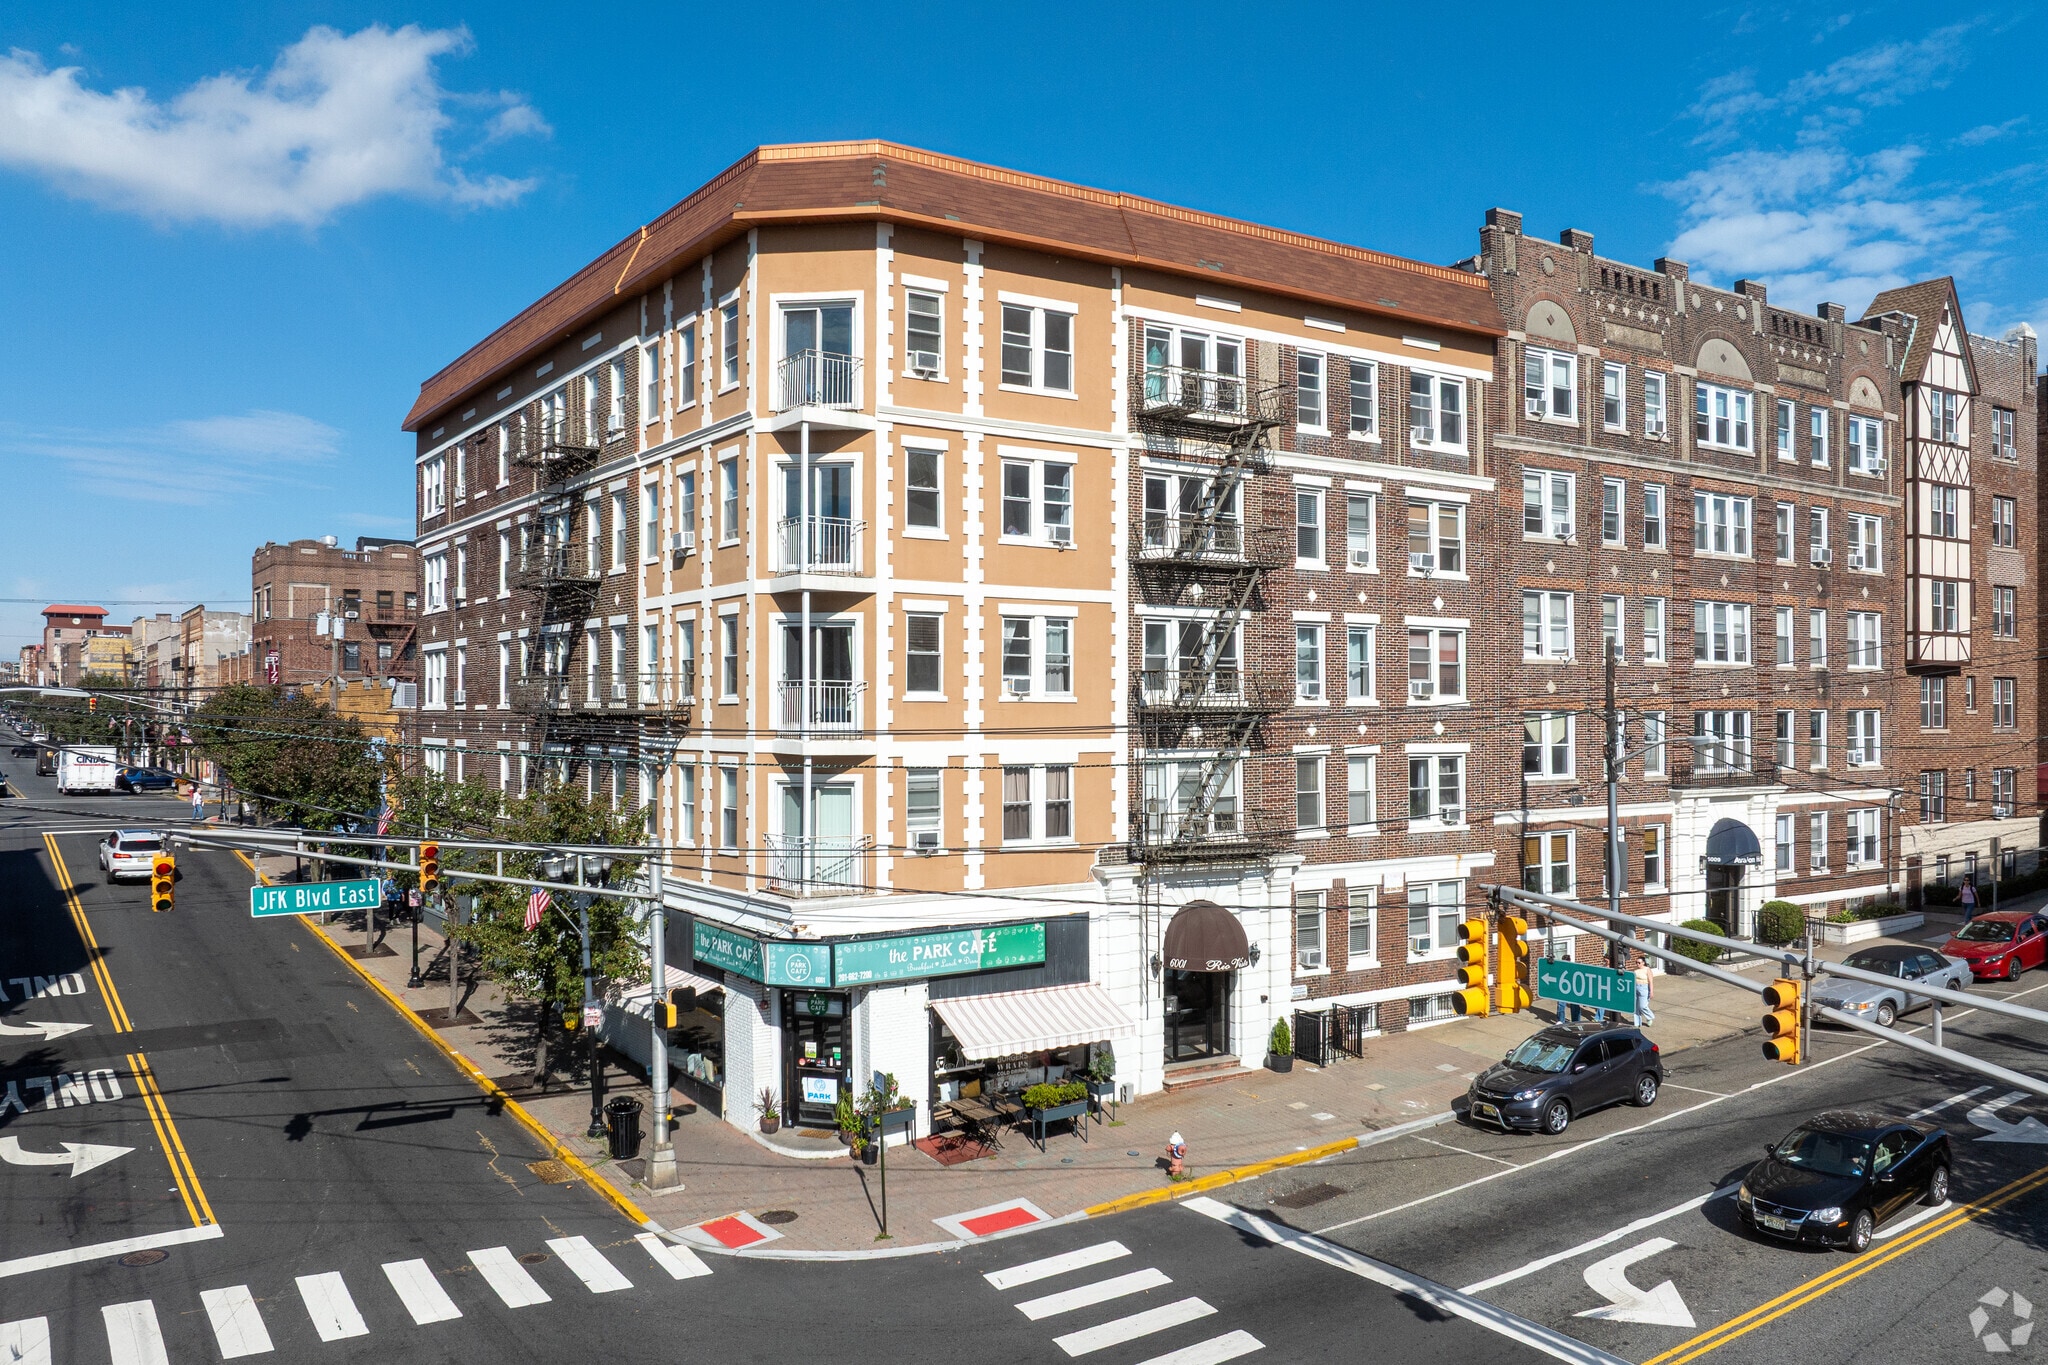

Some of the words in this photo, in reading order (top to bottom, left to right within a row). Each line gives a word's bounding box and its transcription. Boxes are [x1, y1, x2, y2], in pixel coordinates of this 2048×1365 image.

[258, 890, 288, 911] JFK
[295, 888, 331, 908] Blvd
[339, 884, 375, 905] East
[700, 932, 710, 949] the
[712, 937, 734, 957] PARK
[889, 948, 909, 964] the
[912, 941, 953, 961] PARK
[906, 961, 935, 973] Breakfast
[940, 958, 958, 968] Lunch
[1169, 958, 1188, 969] 6001
[1205, 959, 1231, 971] Rio
[1558, 969, 1611, 1002] 60TH
[1616, 978, 1633, 993] ST
[0, 1068, 124, 1117] ONLY
[807, 1092, 832, 1100] PARK
